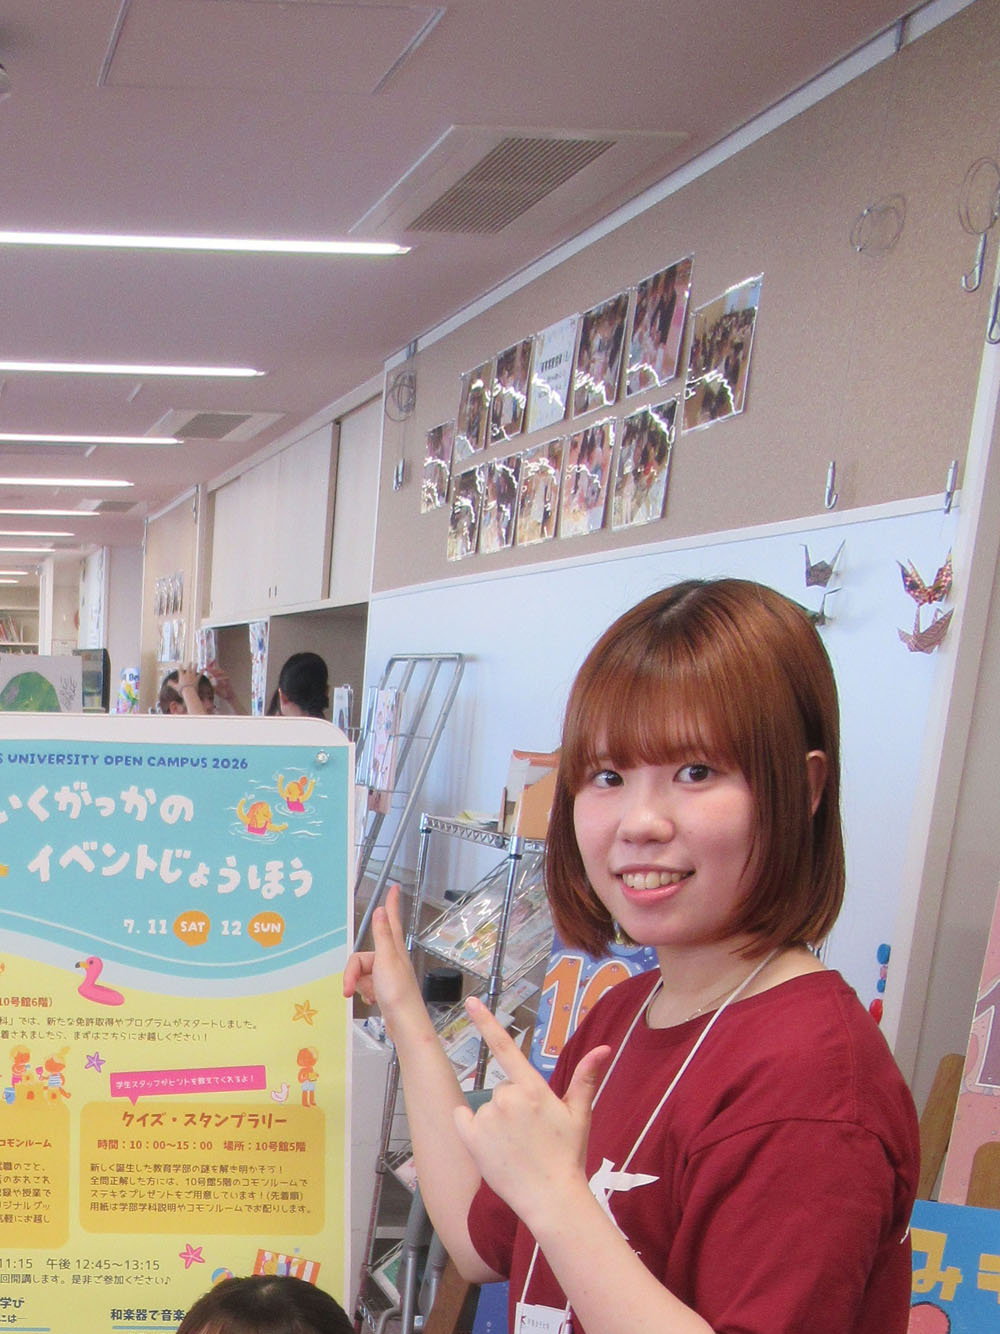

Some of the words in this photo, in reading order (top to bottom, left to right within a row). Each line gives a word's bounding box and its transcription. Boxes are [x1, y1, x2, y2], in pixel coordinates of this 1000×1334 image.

[7, 753, 100, 768] UNIVERSITY
[103, 754, 144, 768] OPEN
[147, 756, 208, 770] CAMPUS
[211, 757, 249, 771] 2026
[27, 840, 313, 899] イベントじょうほう
[180, 920, 206, 934] SAT
[221, 919, 242, 935] 12
[253, 920, 282, 934] SUN
[122, 1112, 288, 1129] クイズ・スタンプラリー
[223, 1140, 307, 1153] 場所：10号館5階
[90, 1163, 284, 1175] 新しく誕生した教育学部の謎を解き明かそう！
[89, 1202, 312, 1214] 用紙は学部学科説明やコモンルームでお配りします。
[46, 1258, 71, 1270] 午後
[111, 1308, 188, 1321] 和楽器で音楽
